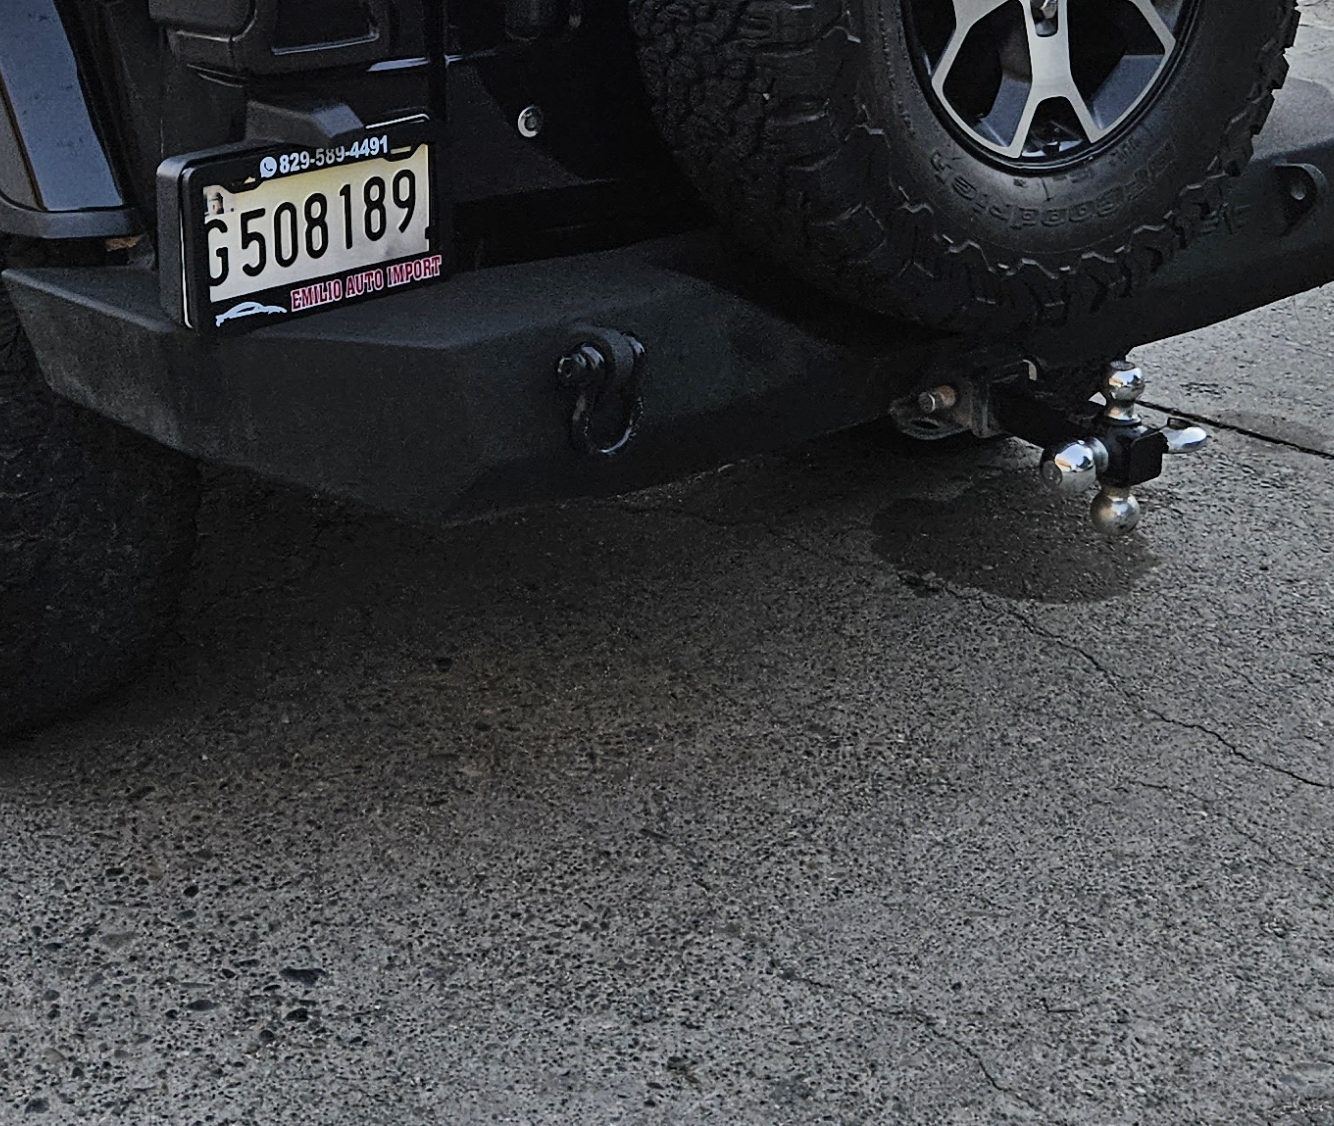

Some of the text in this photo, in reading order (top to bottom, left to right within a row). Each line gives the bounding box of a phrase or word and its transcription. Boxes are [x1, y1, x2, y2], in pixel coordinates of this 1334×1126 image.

[279, 135, 388, 174] 829-589-4491
[291, 254, 442, 312] EMILIO AUTO IMPORT
